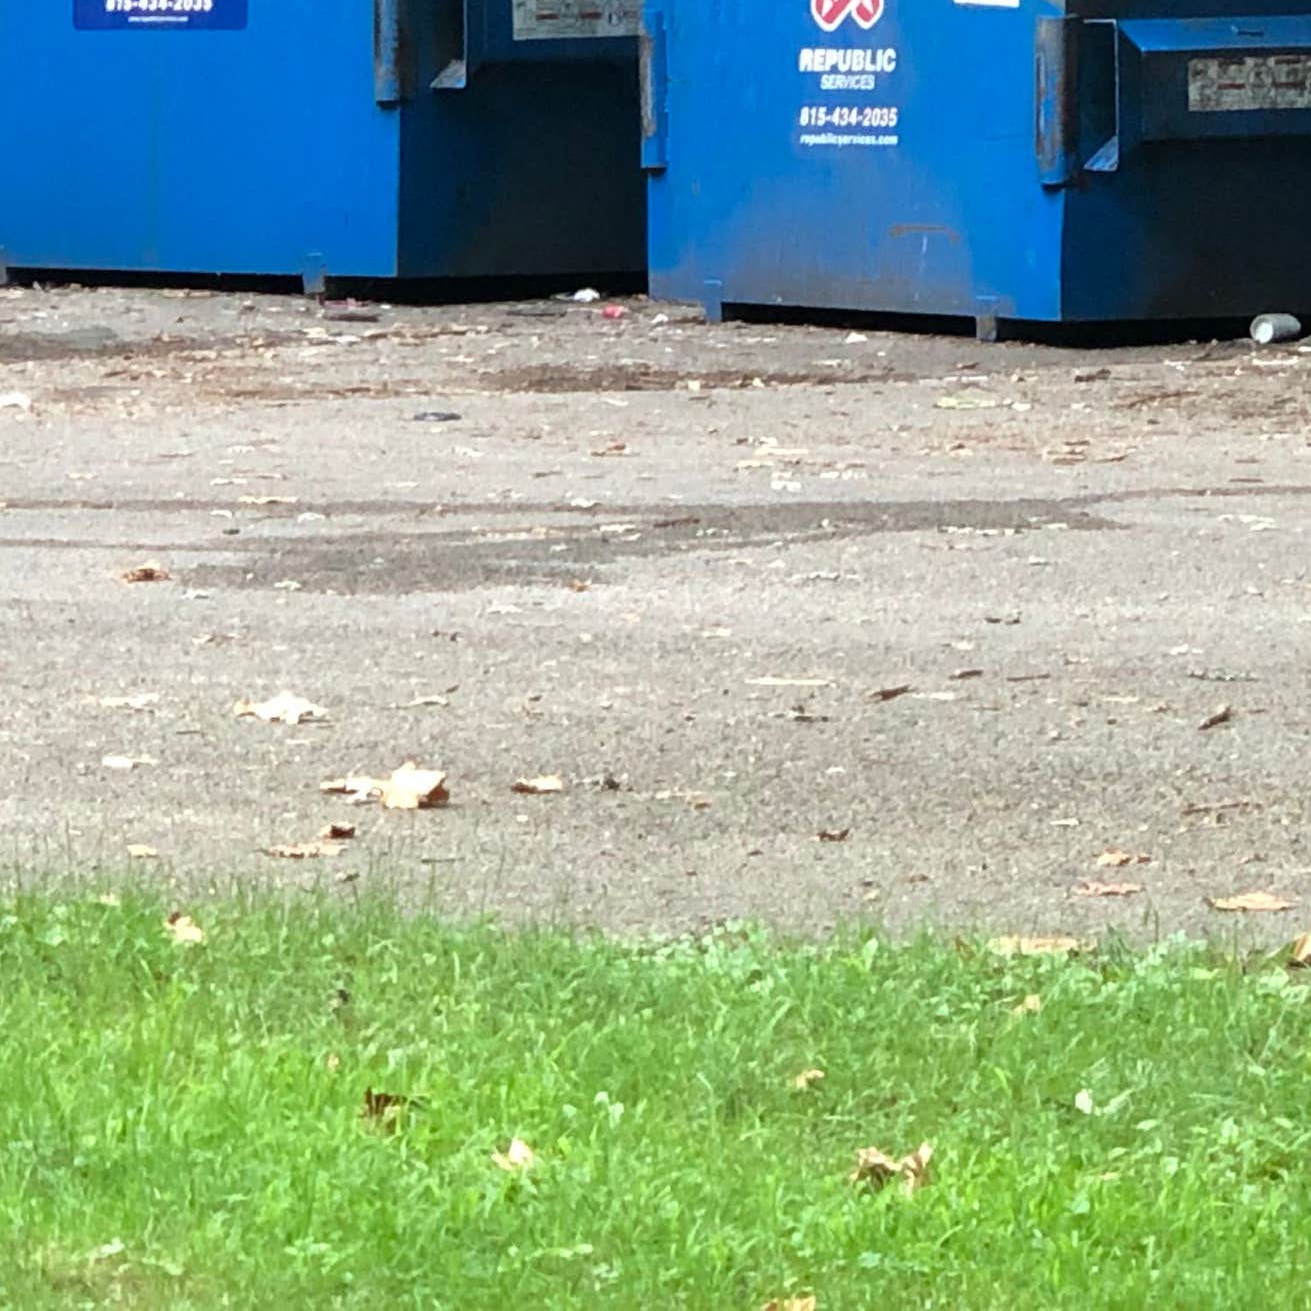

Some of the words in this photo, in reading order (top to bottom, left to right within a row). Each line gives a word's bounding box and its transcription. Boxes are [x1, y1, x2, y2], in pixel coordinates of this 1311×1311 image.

[799, 48, 897, 72] REPUBLIC
[820, 74, 875, 90] SERVICES
[800, 106, 898, 127] 815-434-2035
